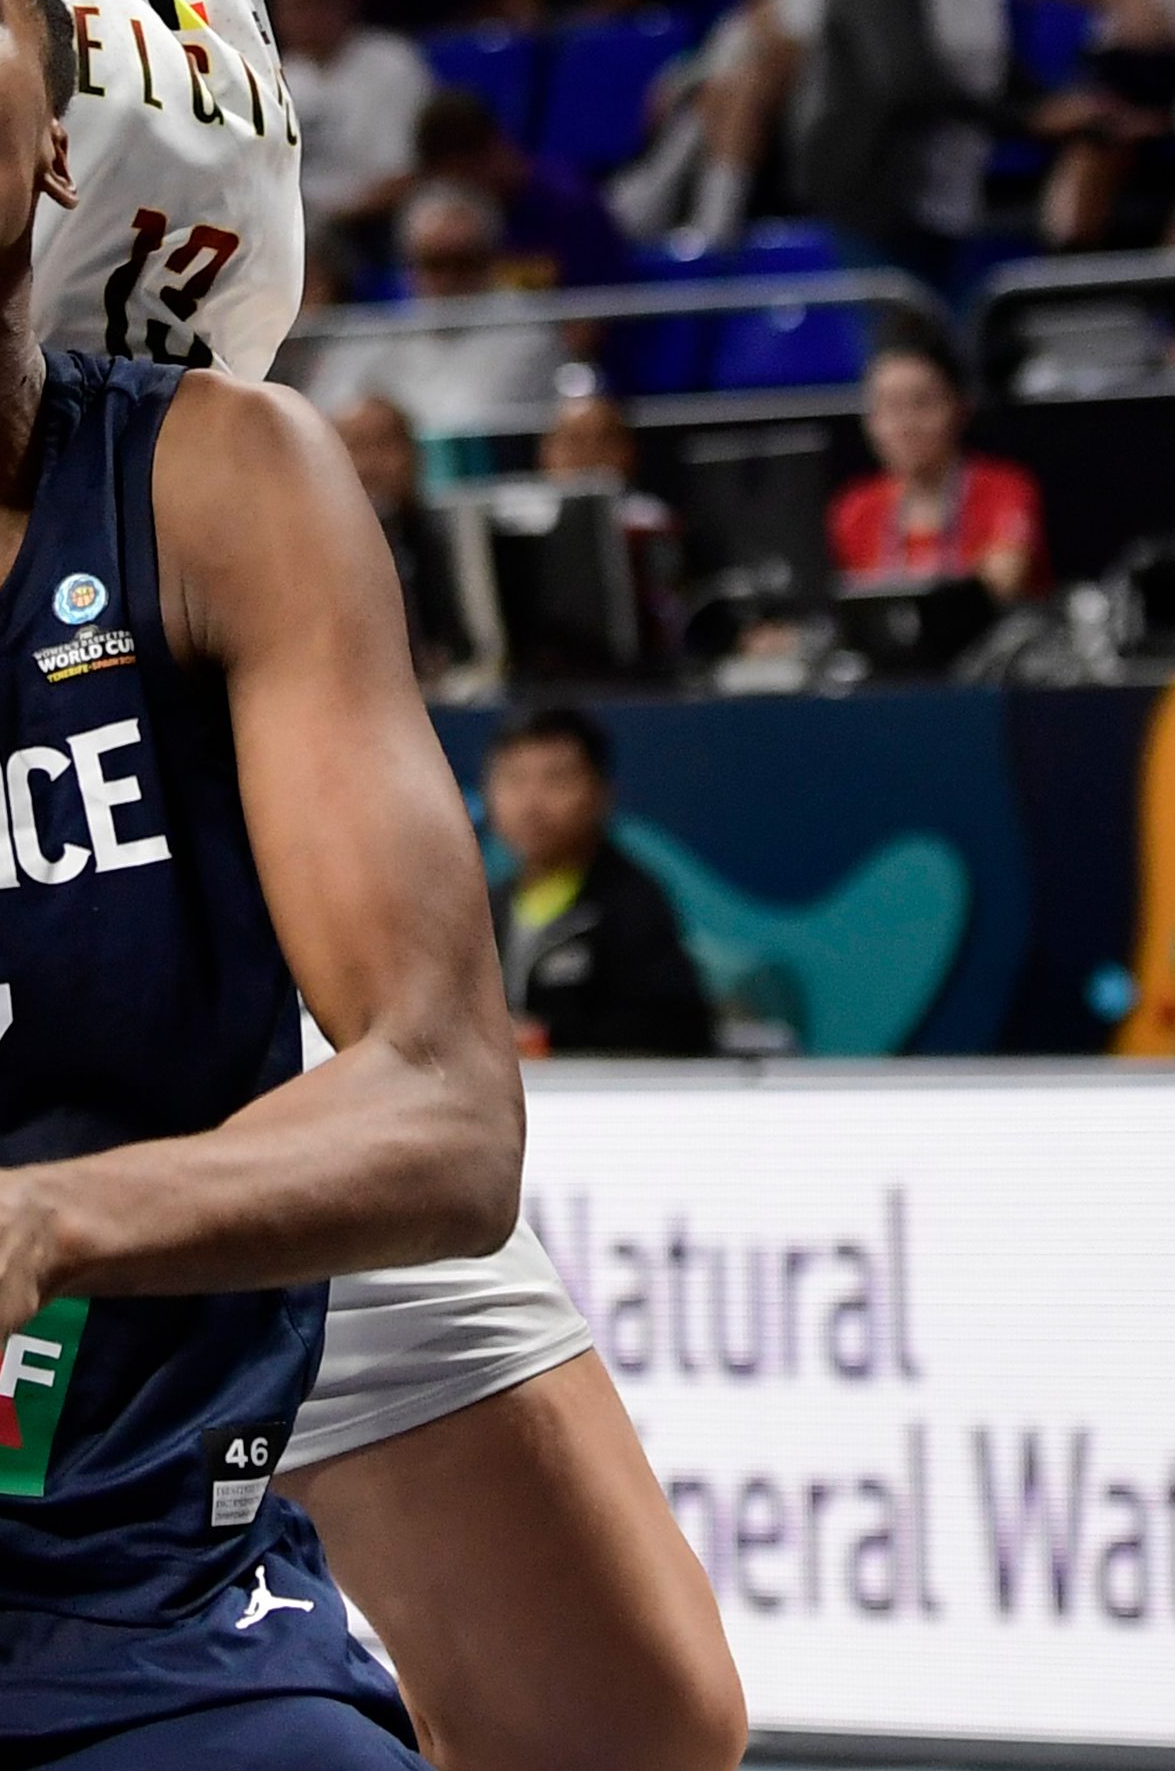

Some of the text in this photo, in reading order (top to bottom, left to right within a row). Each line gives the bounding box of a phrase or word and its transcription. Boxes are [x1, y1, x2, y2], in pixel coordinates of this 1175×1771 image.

[74, 6, 298, 146] ELGI
[37, 643, 103, 673] WORLD
[525, 1183, 921, 1385] Natural
[224, 1436, 270, 1469] 46
[660, 1418, 1175, 1627] neral Wa
